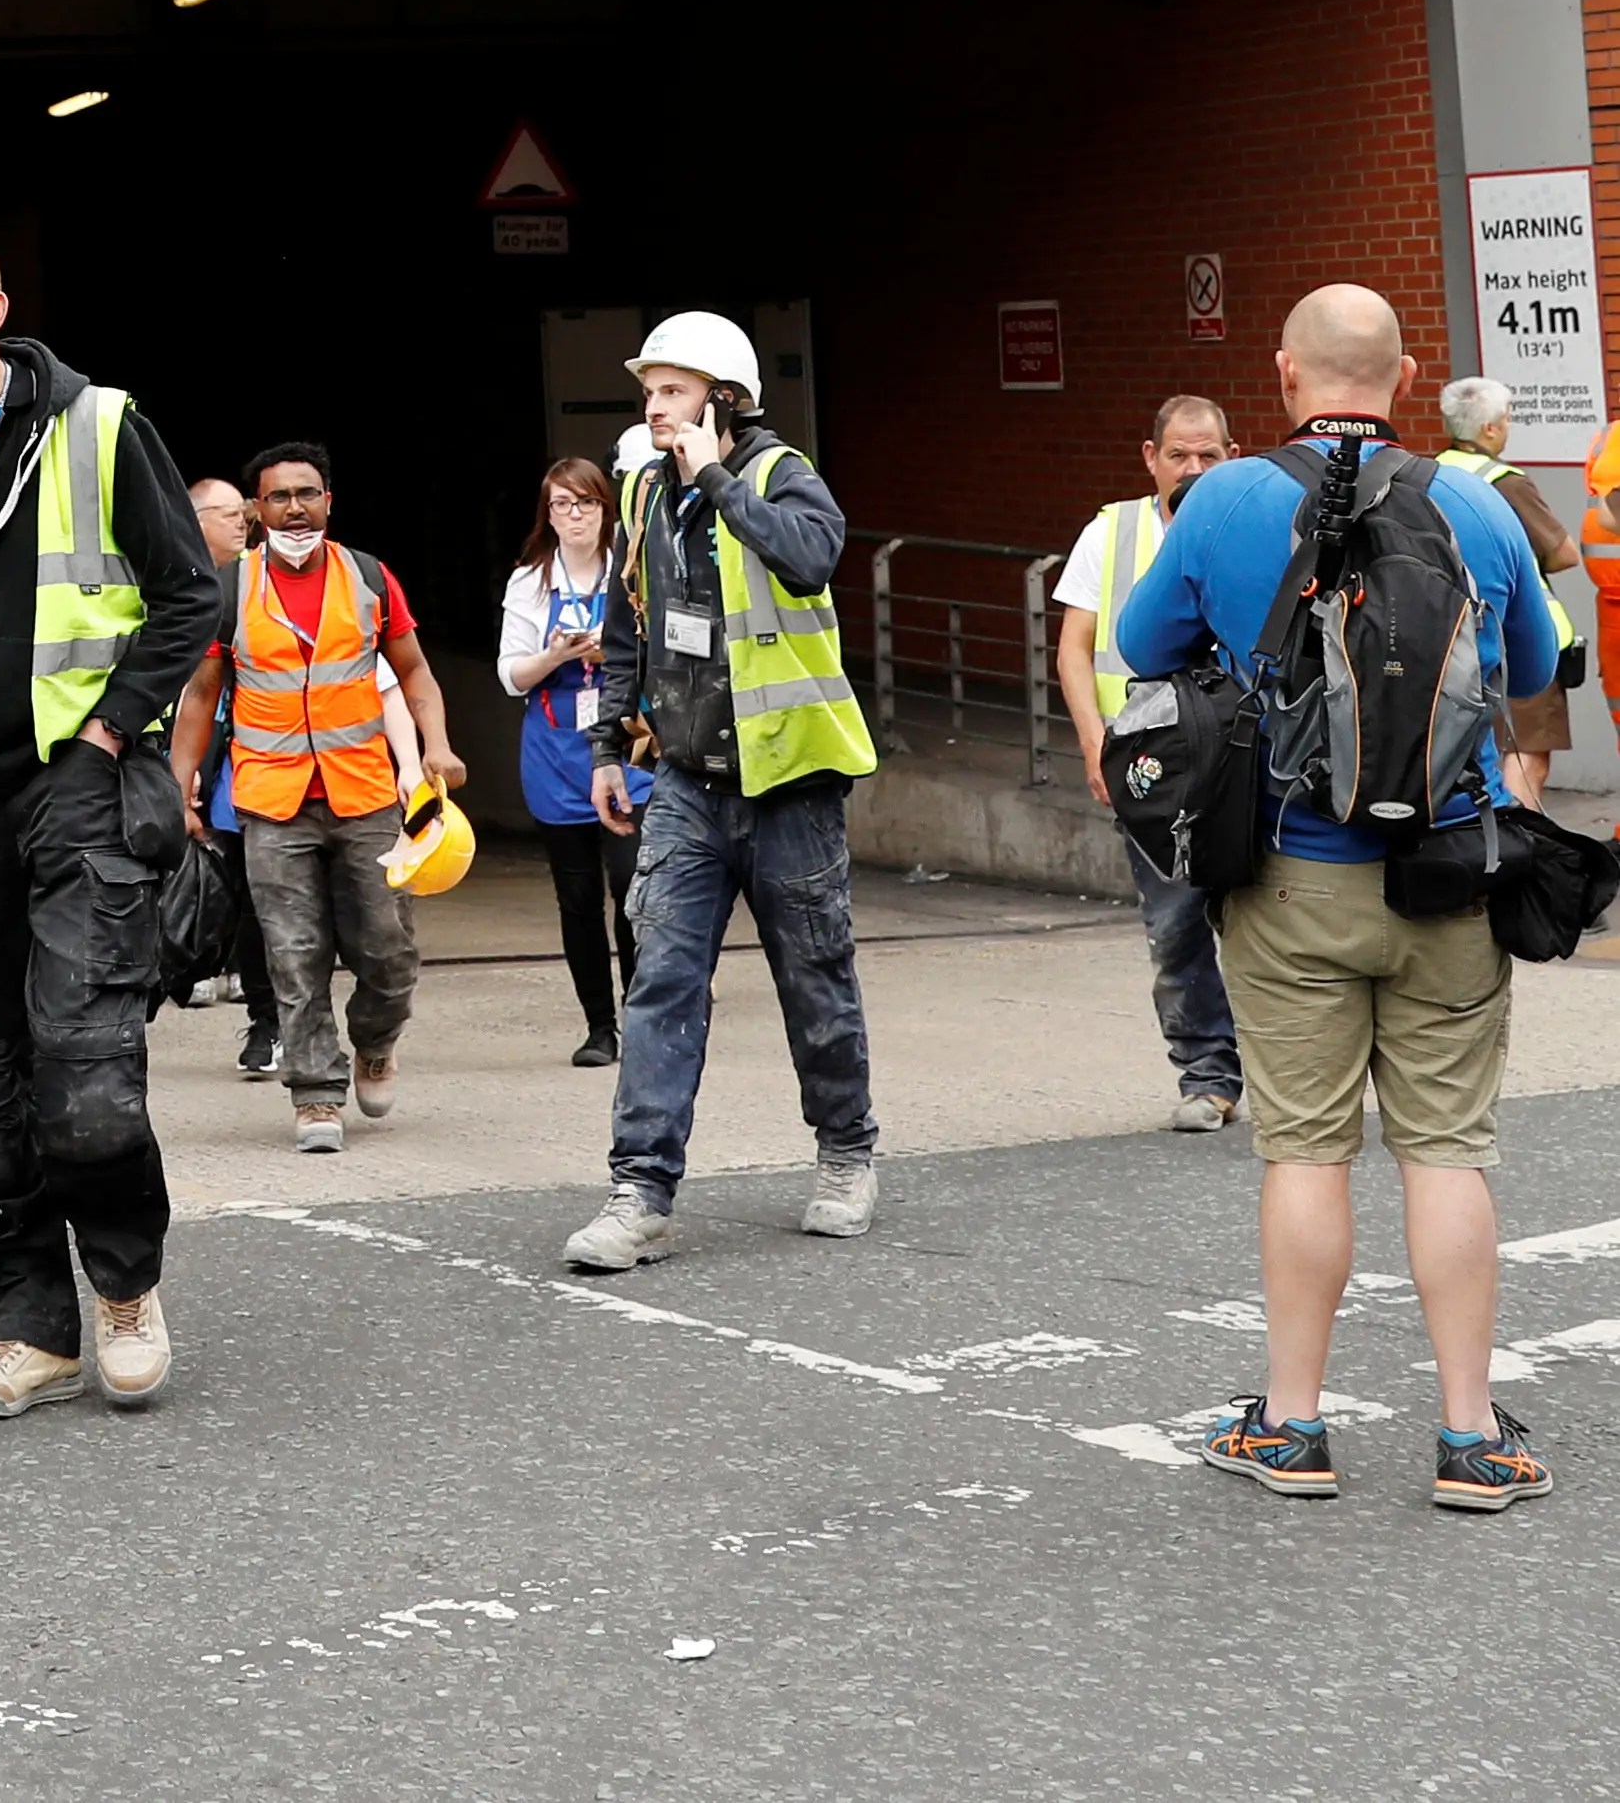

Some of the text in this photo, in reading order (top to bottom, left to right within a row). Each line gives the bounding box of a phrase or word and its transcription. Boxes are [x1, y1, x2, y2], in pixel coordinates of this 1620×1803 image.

[1480, 215, 1584, 241] WARNING
[1484, 269, 1588, 293] Max height
[1497, 299, 1581, 336] 4.1m
[1519, 384, 1539, 396] not
[1540, 384, 1590, 401] progress
[1540, 398, 1562, 410] this
[1564, 398, 1594, 411] point
[1545, 413, 1598, 424] unknown
[1310, 419, 1377, 436] Canon
